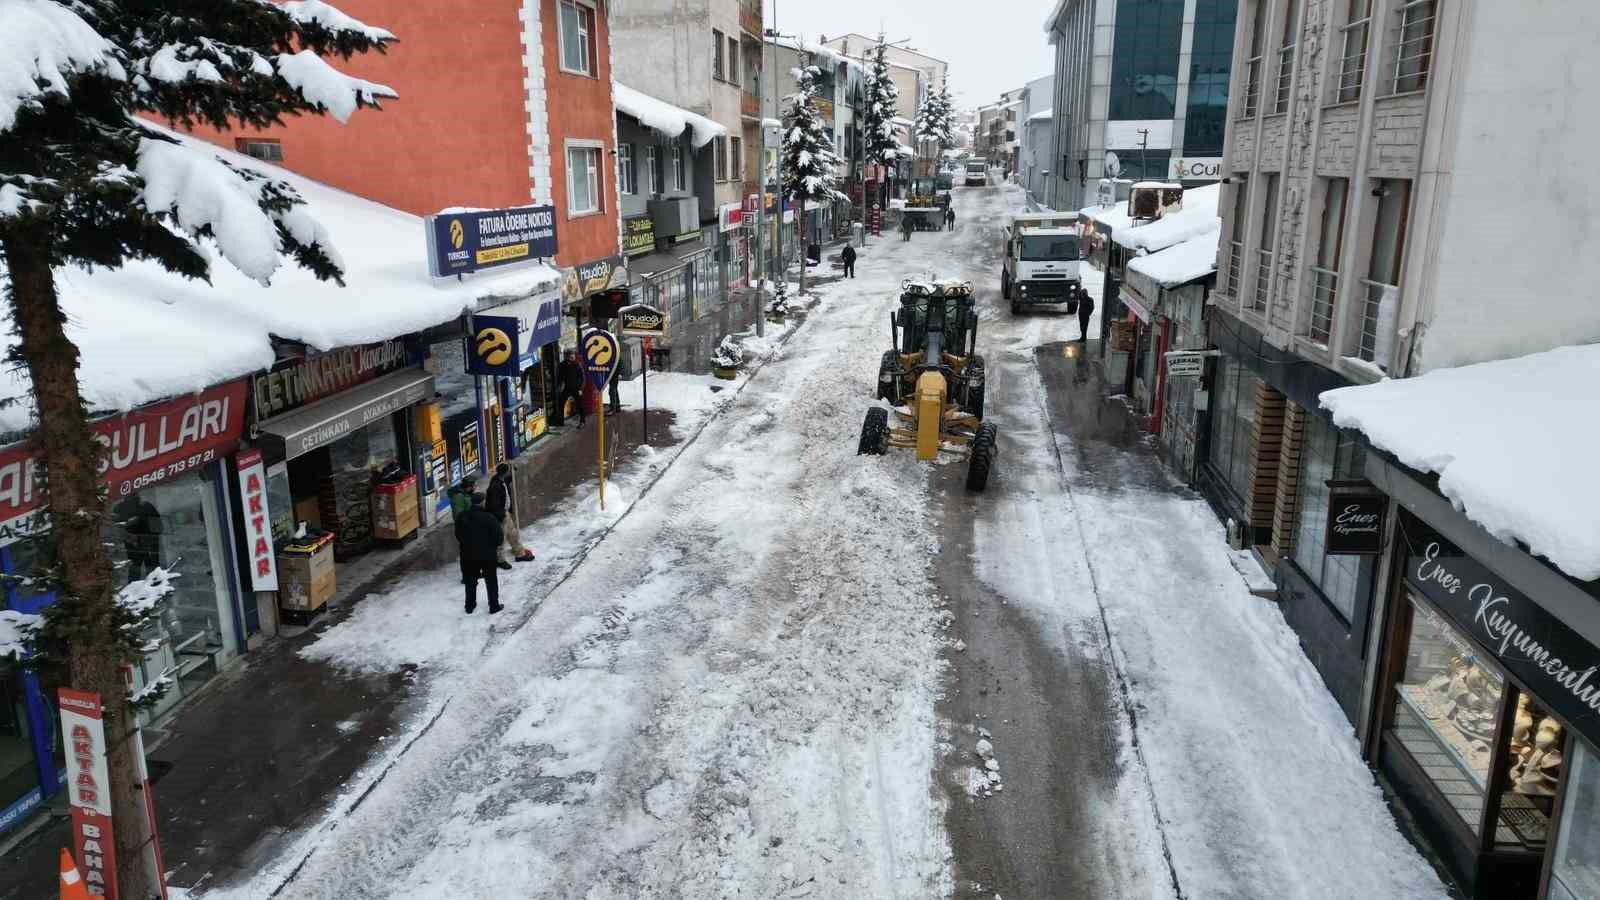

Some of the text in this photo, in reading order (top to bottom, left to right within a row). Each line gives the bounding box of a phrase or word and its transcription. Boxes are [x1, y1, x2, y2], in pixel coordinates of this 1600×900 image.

[1191, 162, 1220, 177] Cul
[479, 211, 552, 234] FATURA ÖDEME NOKTASI
[301, 419, 350, 450] ÇETİNKAYA
[133, 449, 214, 489] 0546 713 97 21
[246, 472, 271, 579] AKTAR
[1335, 503, 1378, 524] Enes
[1417, 541, 1462, 594] Enes
[1468, 583, 1600, 716] Kuyumculu
[71, 724, 98, 803] AKTAR
